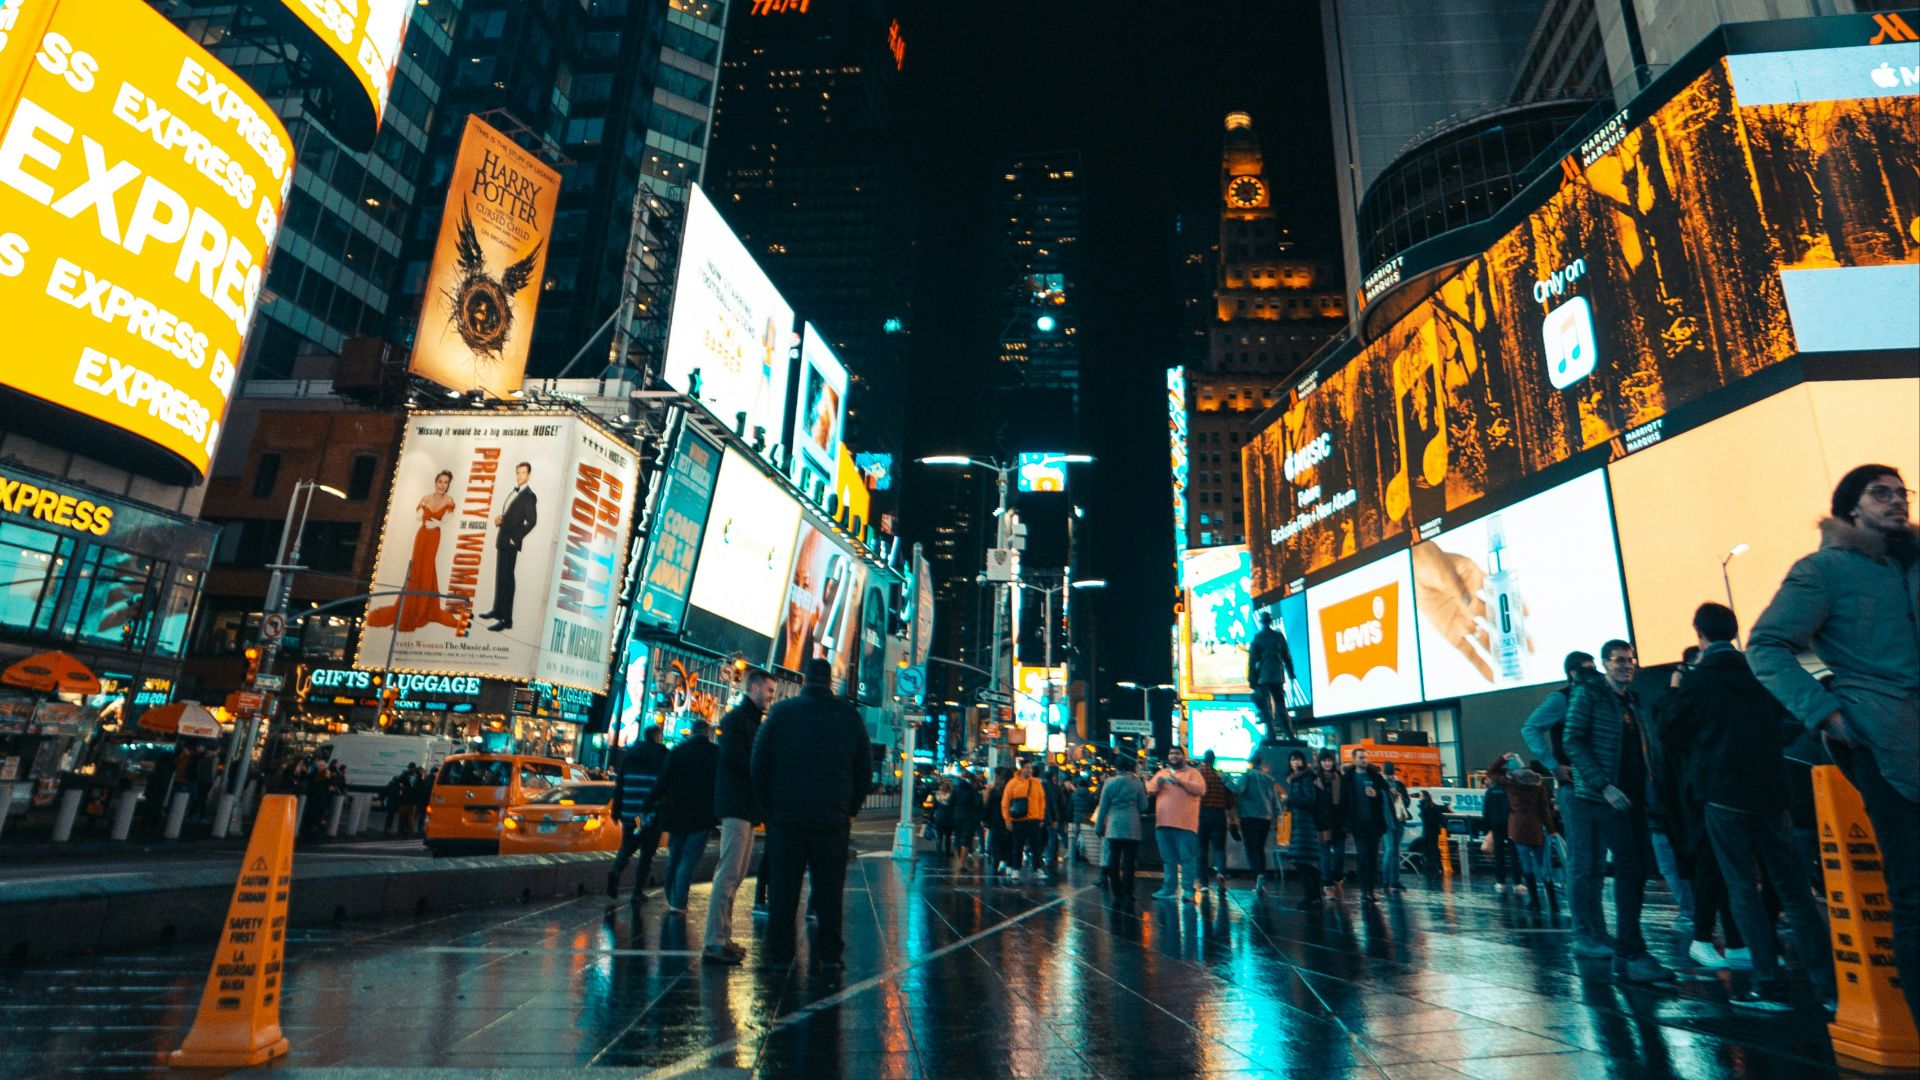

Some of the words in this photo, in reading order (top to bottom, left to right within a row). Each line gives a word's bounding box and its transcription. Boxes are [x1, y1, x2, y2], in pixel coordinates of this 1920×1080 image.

[176, 56, 287, 180] EXPRESS
[1581, 109, 1628, 154] MARRIOTT
[112, 81, 256, 209] EXPRESS
[1583, 127, 1626, 167] MARQUIS
[482, 148, 542, 206] HARRY
[471, 168, 538, 231] POTTER
[476, 202, 506, 226] CURSED
[507, 221, 530, 241] CHILD
[1365, 256, 1403, 289] MARRIOTT
[1366, 271, 1400, 302] MARQUIS
[1534, 270, 1564, 303] Only
[1565, 258, 1585, 282] on
[46, 257, 209, 369] EXPRESS
[73, 346, 210, 444] EXPRESS
[452, 427, 471, 436] would
[473, 427, 482, 436] be
[1625, 419, 1662, 442] MARRIOTT
[1627, 431, 1661, 453] MARQUIS
[461, 447, 501, 519] PRETTY
[468, 520, 488, 531] MUSICAL
[556, 462, 602, 616] WOMAN
[664, 507, 701, 546] COME
[582, 471, 624, 624] PRETTY
[395, 640, 510, 653] rettyWomanTheMusical.com
[550, 617, 568, 654] THE
[567, 622, 603, 663] MUSICAL
[311, 668, 370, 687] GIFTS
[386, 673, 482, 695] LUGGAGE
[1455, 794, 1485, 806] POL
[229, 917, 263, 929] SAFETY
[229, 931, 256, 943] FIRST
[233, 949, 245, 962] LA
